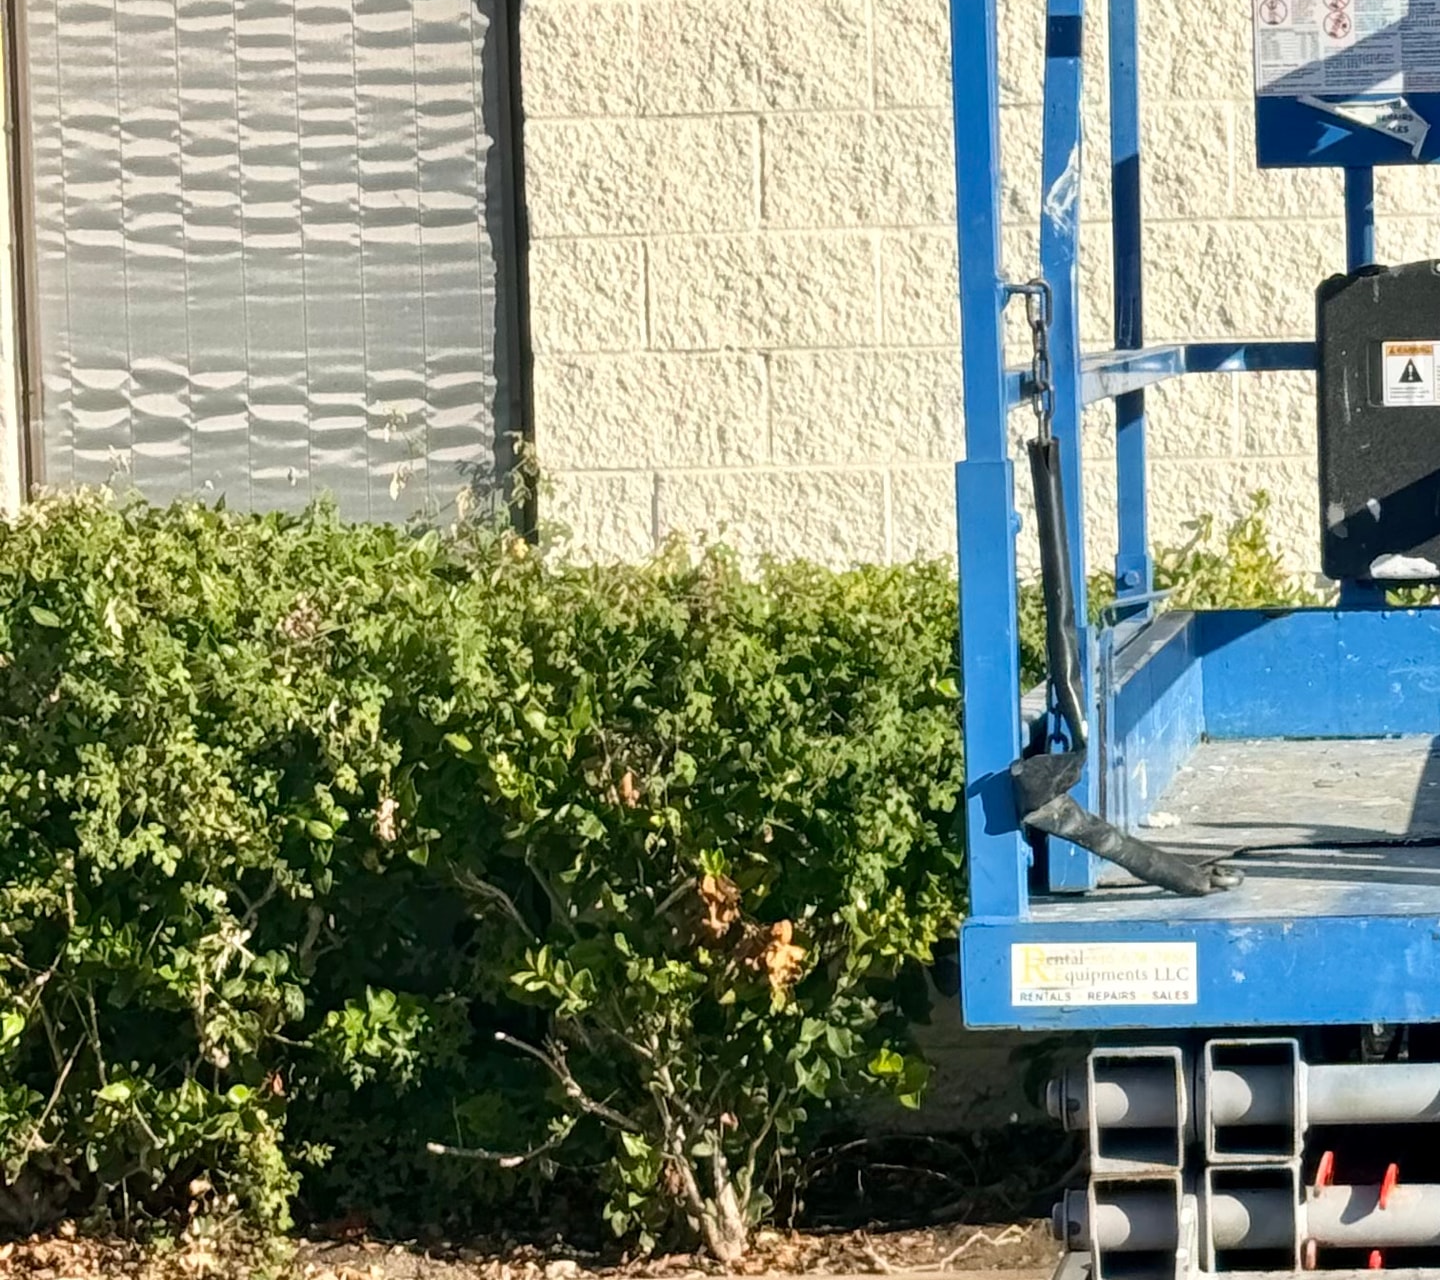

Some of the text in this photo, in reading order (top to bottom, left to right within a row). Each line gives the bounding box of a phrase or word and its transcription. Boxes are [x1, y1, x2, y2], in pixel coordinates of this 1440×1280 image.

[1019, 946, 1084, 983] Rental
[1154, 967, 1190, 982] LLC
[1019, 990, 1190, 1001] RENTALS REPAIRS SALES
